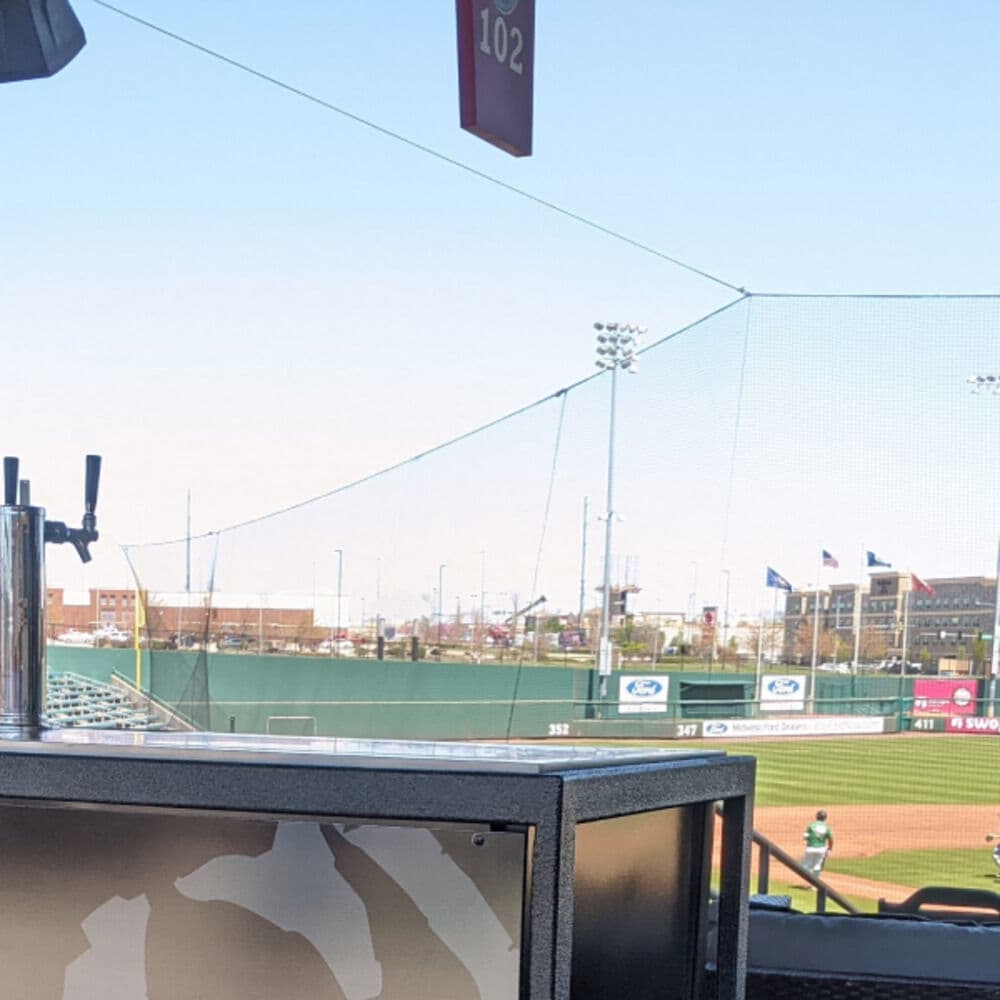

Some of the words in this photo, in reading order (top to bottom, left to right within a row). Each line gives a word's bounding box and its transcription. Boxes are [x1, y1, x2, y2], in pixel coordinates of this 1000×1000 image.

[481, 8, 523, 75] 102
[915, 719, 934, 729] 411
[677, 725, 697, 736] 347
